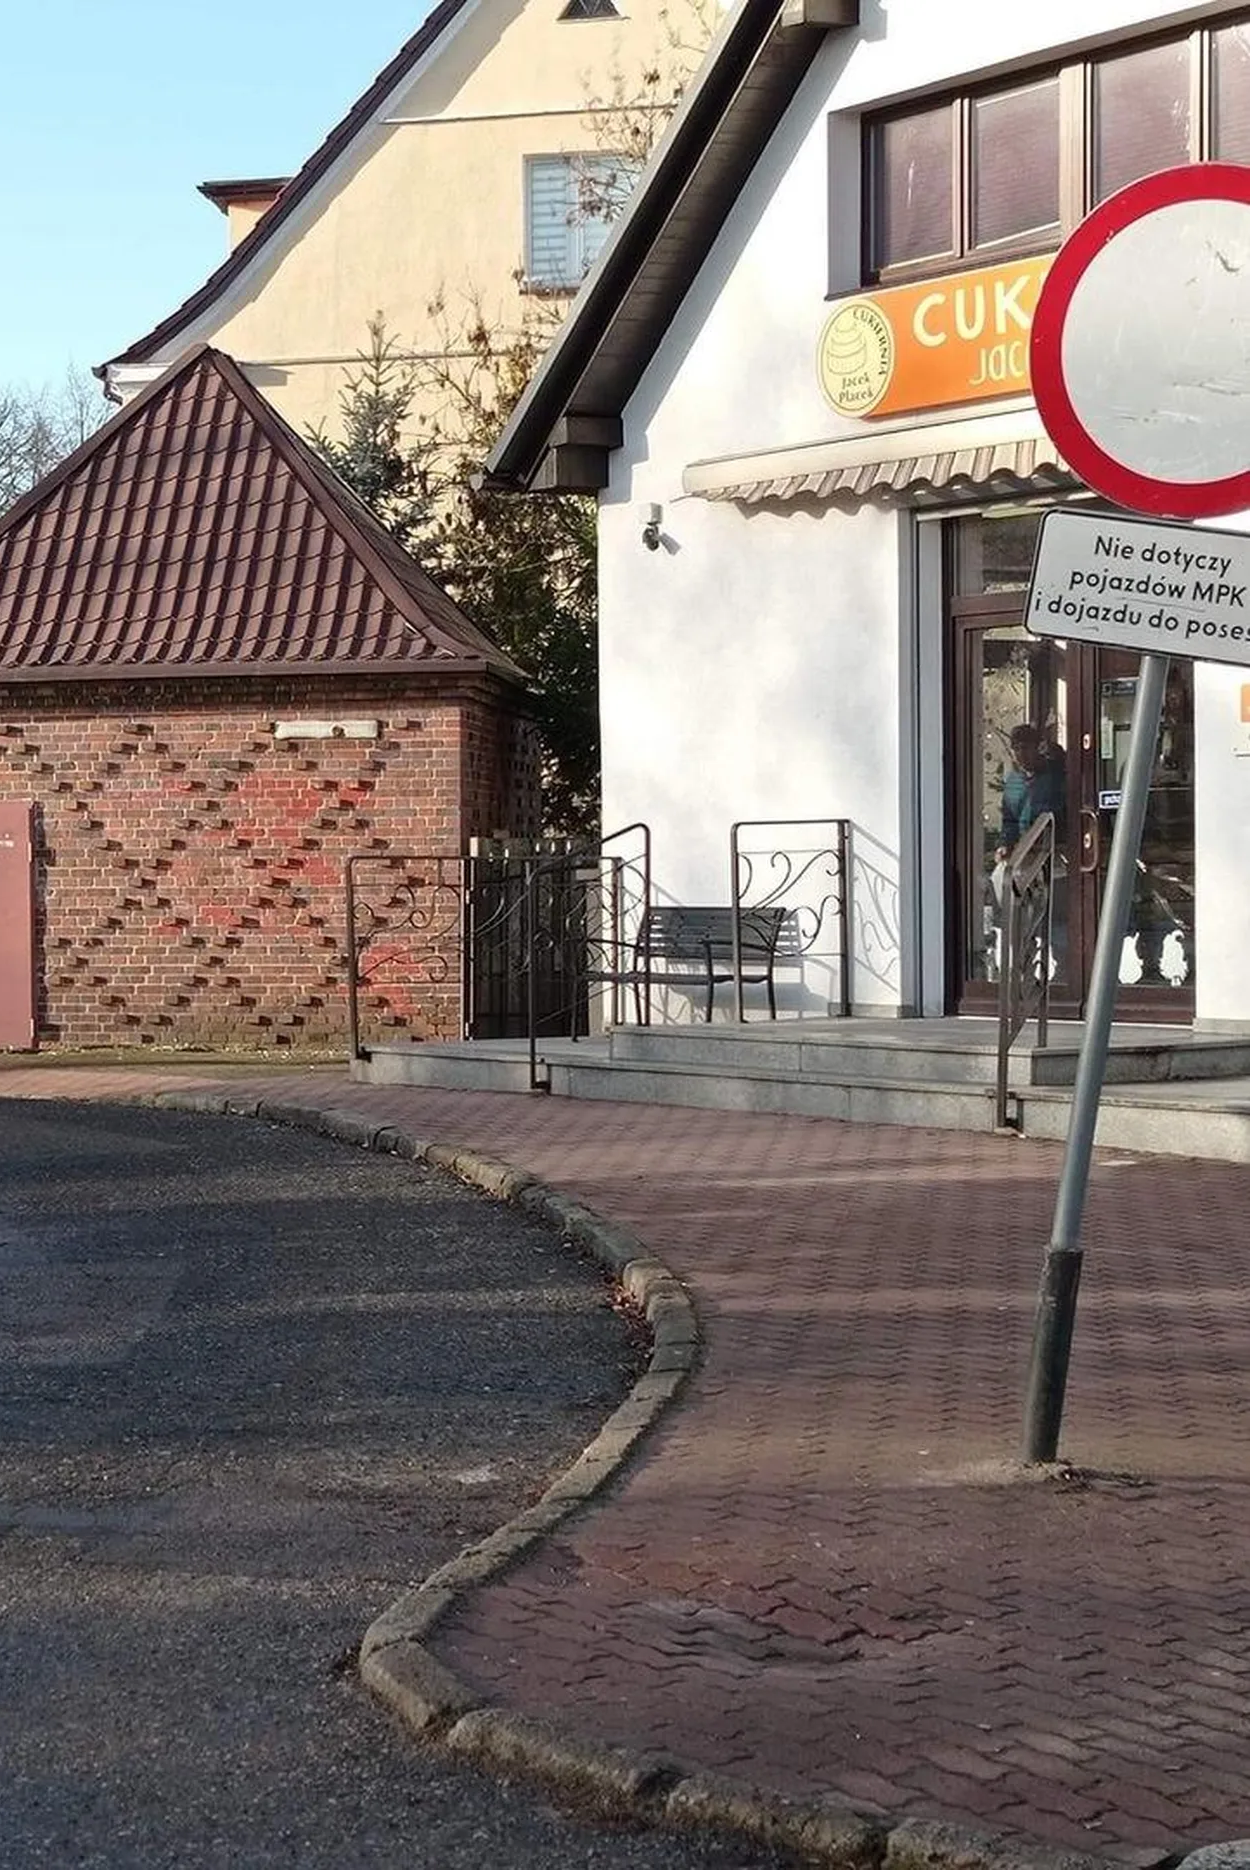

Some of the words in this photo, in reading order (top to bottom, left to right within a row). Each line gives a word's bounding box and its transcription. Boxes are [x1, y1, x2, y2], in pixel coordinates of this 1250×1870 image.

[913, 272, 1047, 347] CUK
[1094, 535, 1135, 560] Nie
[1141, 542, 1232, 578] dotyczy
[1069, 567, 1187, 599] pojazdów
[1192, 580, 1247, 608] MPK
[1035, 590, 1043, 612] i
[1047, 595, 1143, 626] dojazdu
[1148, 608, 1180, 632] do
